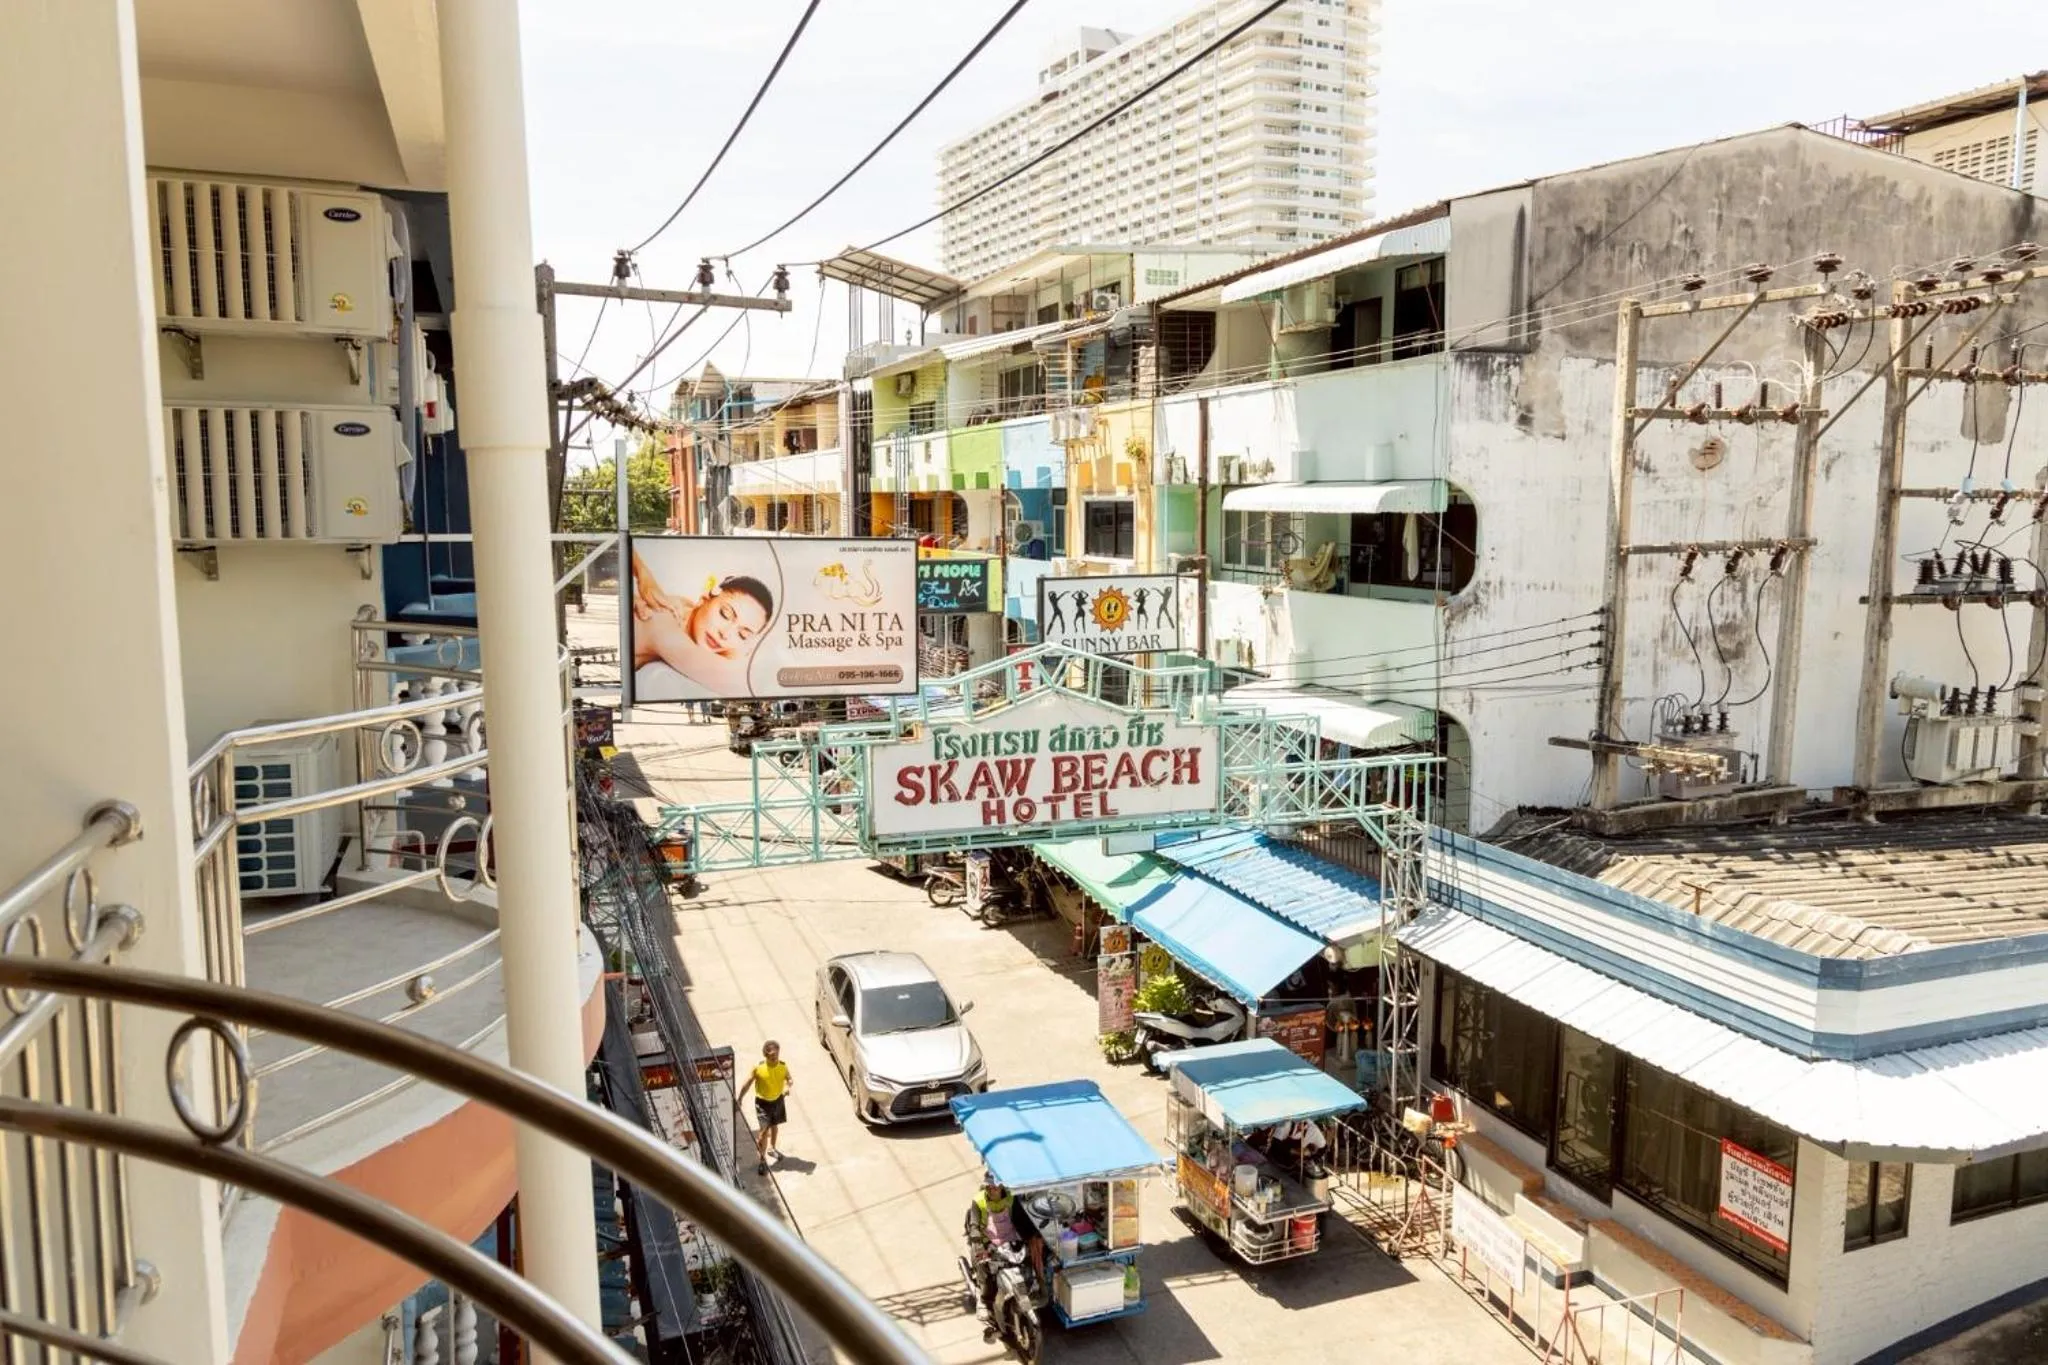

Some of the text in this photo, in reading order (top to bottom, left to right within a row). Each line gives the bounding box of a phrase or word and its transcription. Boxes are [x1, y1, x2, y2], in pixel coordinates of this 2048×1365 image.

[933, 564, 981, 578] PEOPLE
[788, 632, 904, 652] Massage & Spa
[1127, 635, 1161, 650] BAR
[932, 726, 1040, 761] โรงแรม
[1126, 716, 1164, 748] บีช
[894, 748, 1202, 806] SKAW BEACH
[982, 792, 1118, 825] HOTEL
